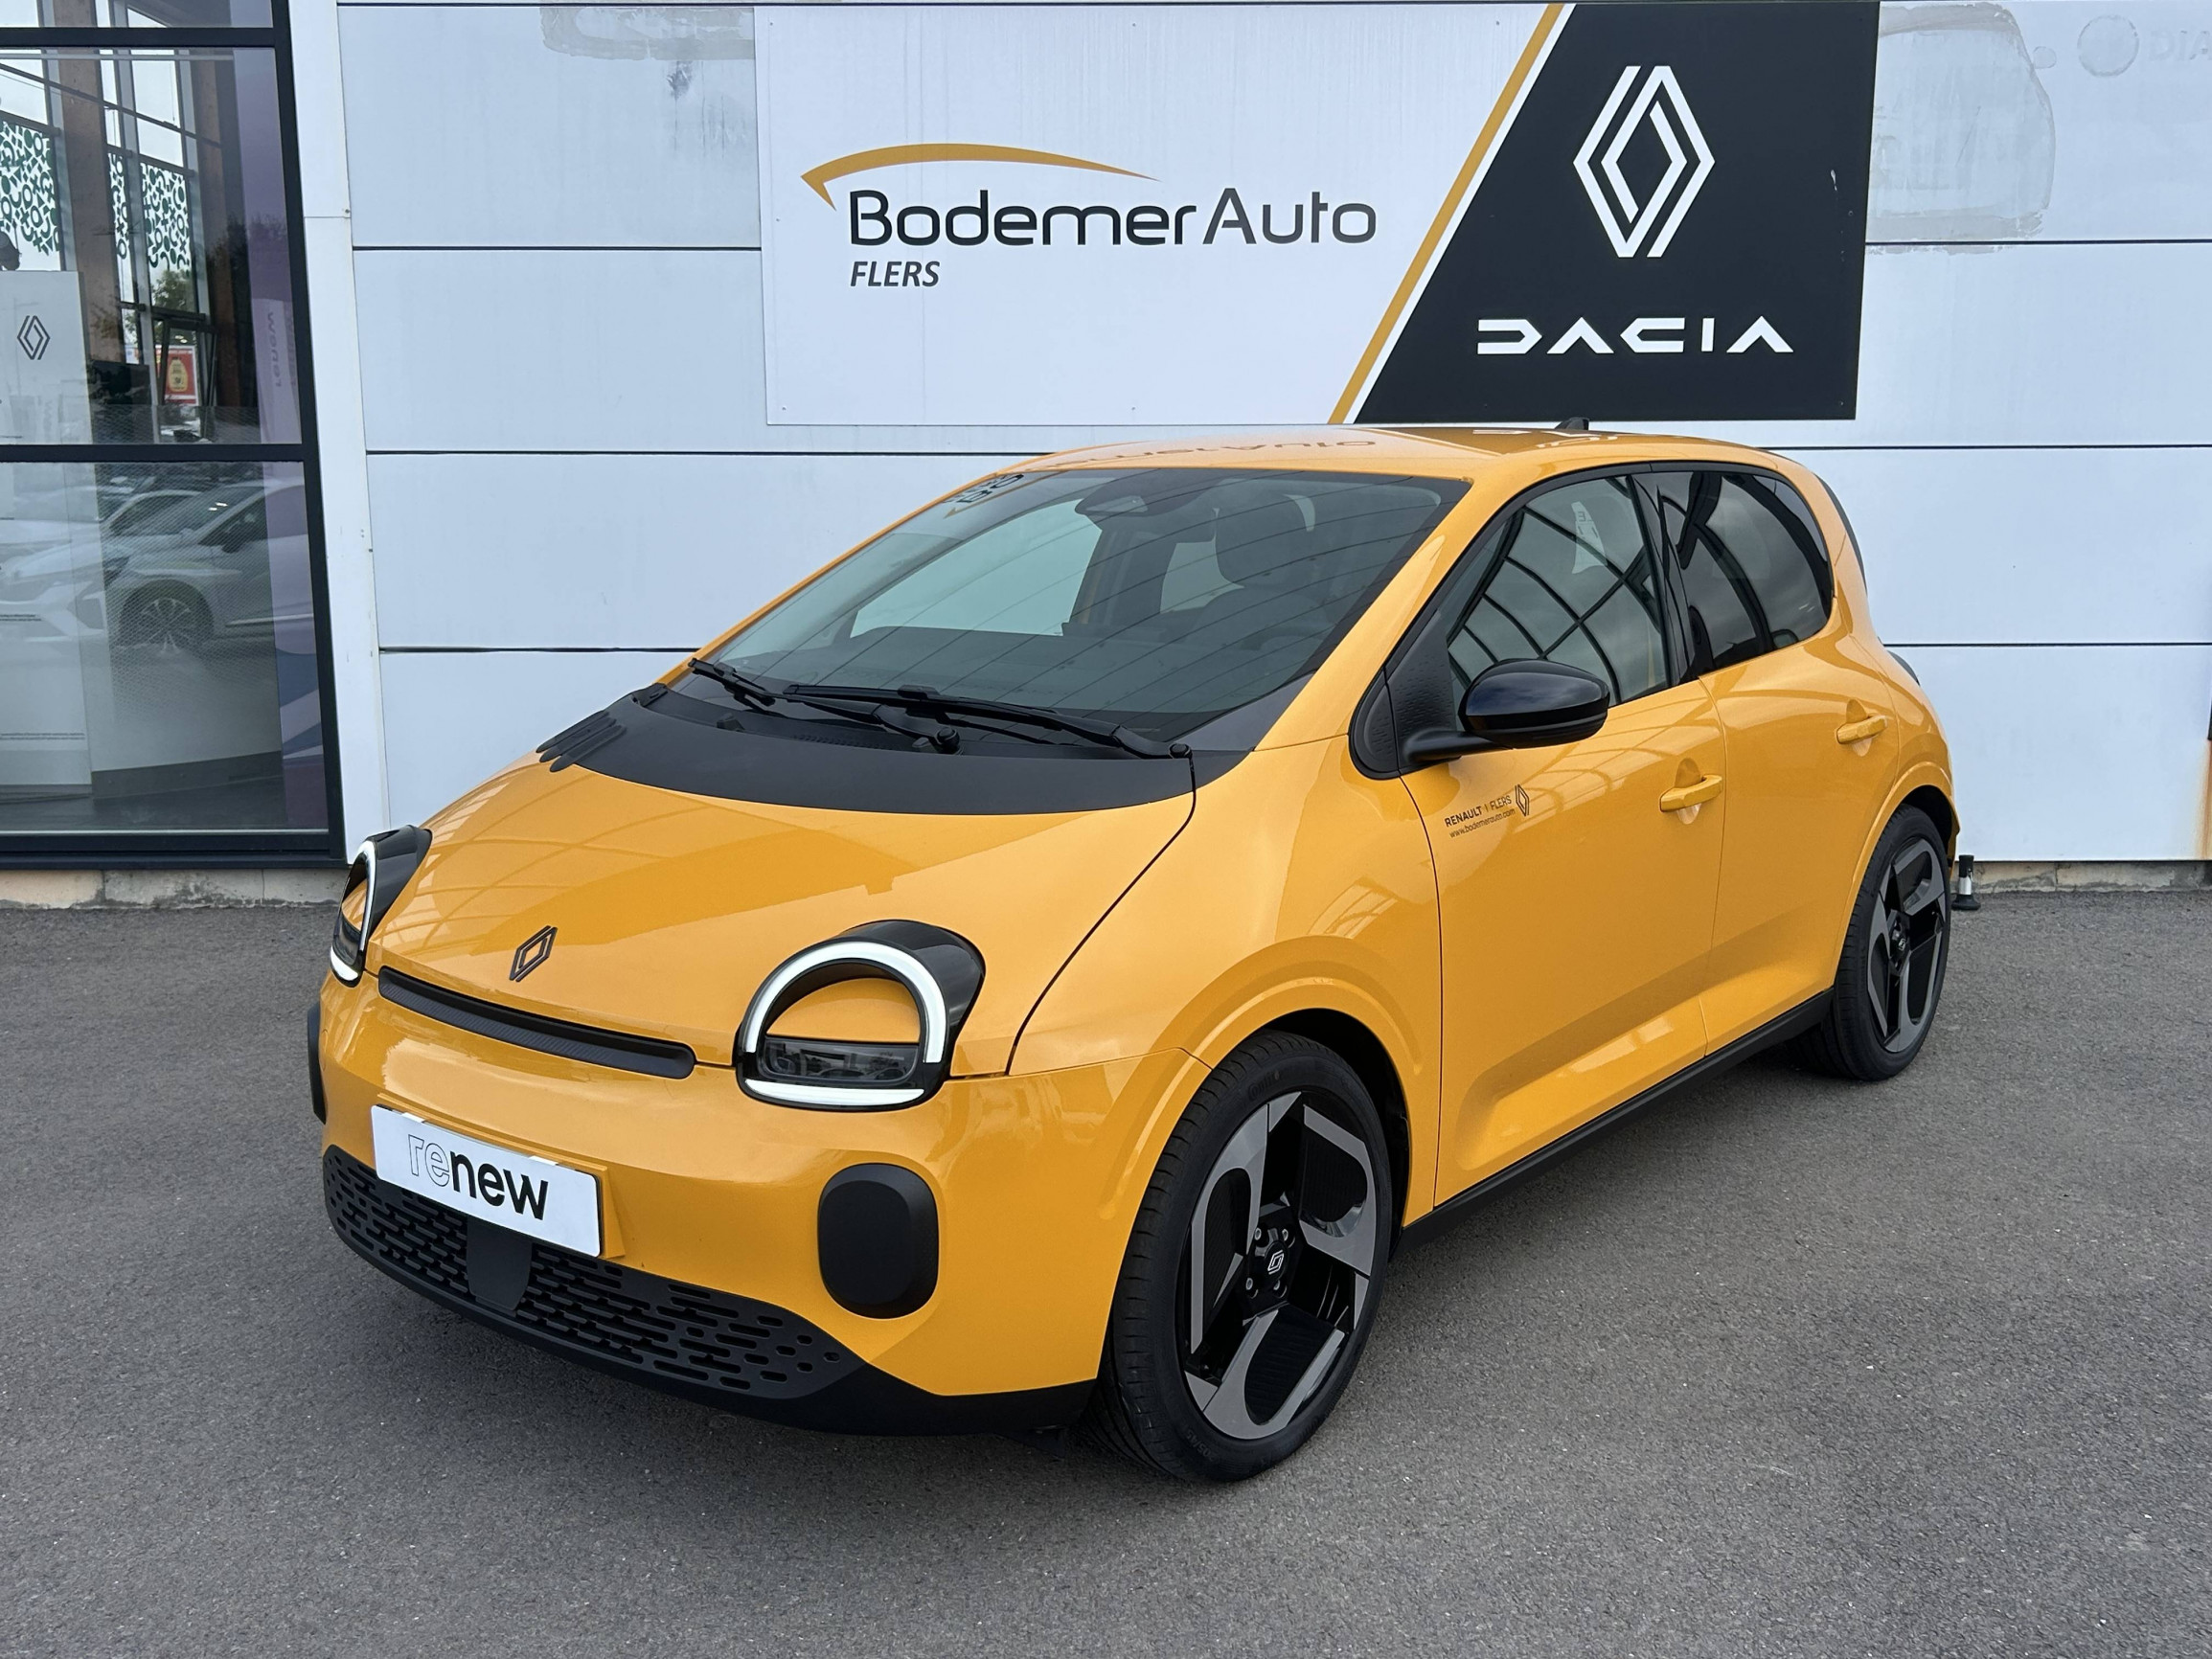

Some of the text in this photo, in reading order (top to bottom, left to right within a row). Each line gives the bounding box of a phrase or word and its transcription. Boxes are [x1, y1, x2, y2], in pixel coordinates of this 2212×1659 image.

[850, 261, 941, 287] FLERS
[1476, 316, 1794, 355] DACIA
[1444, 795, 1512, 828] RENAULT FLERS
[1449, 808, 1516, 838] www.bodemerauto.com
[408, 1134, 549, 1221] renew
